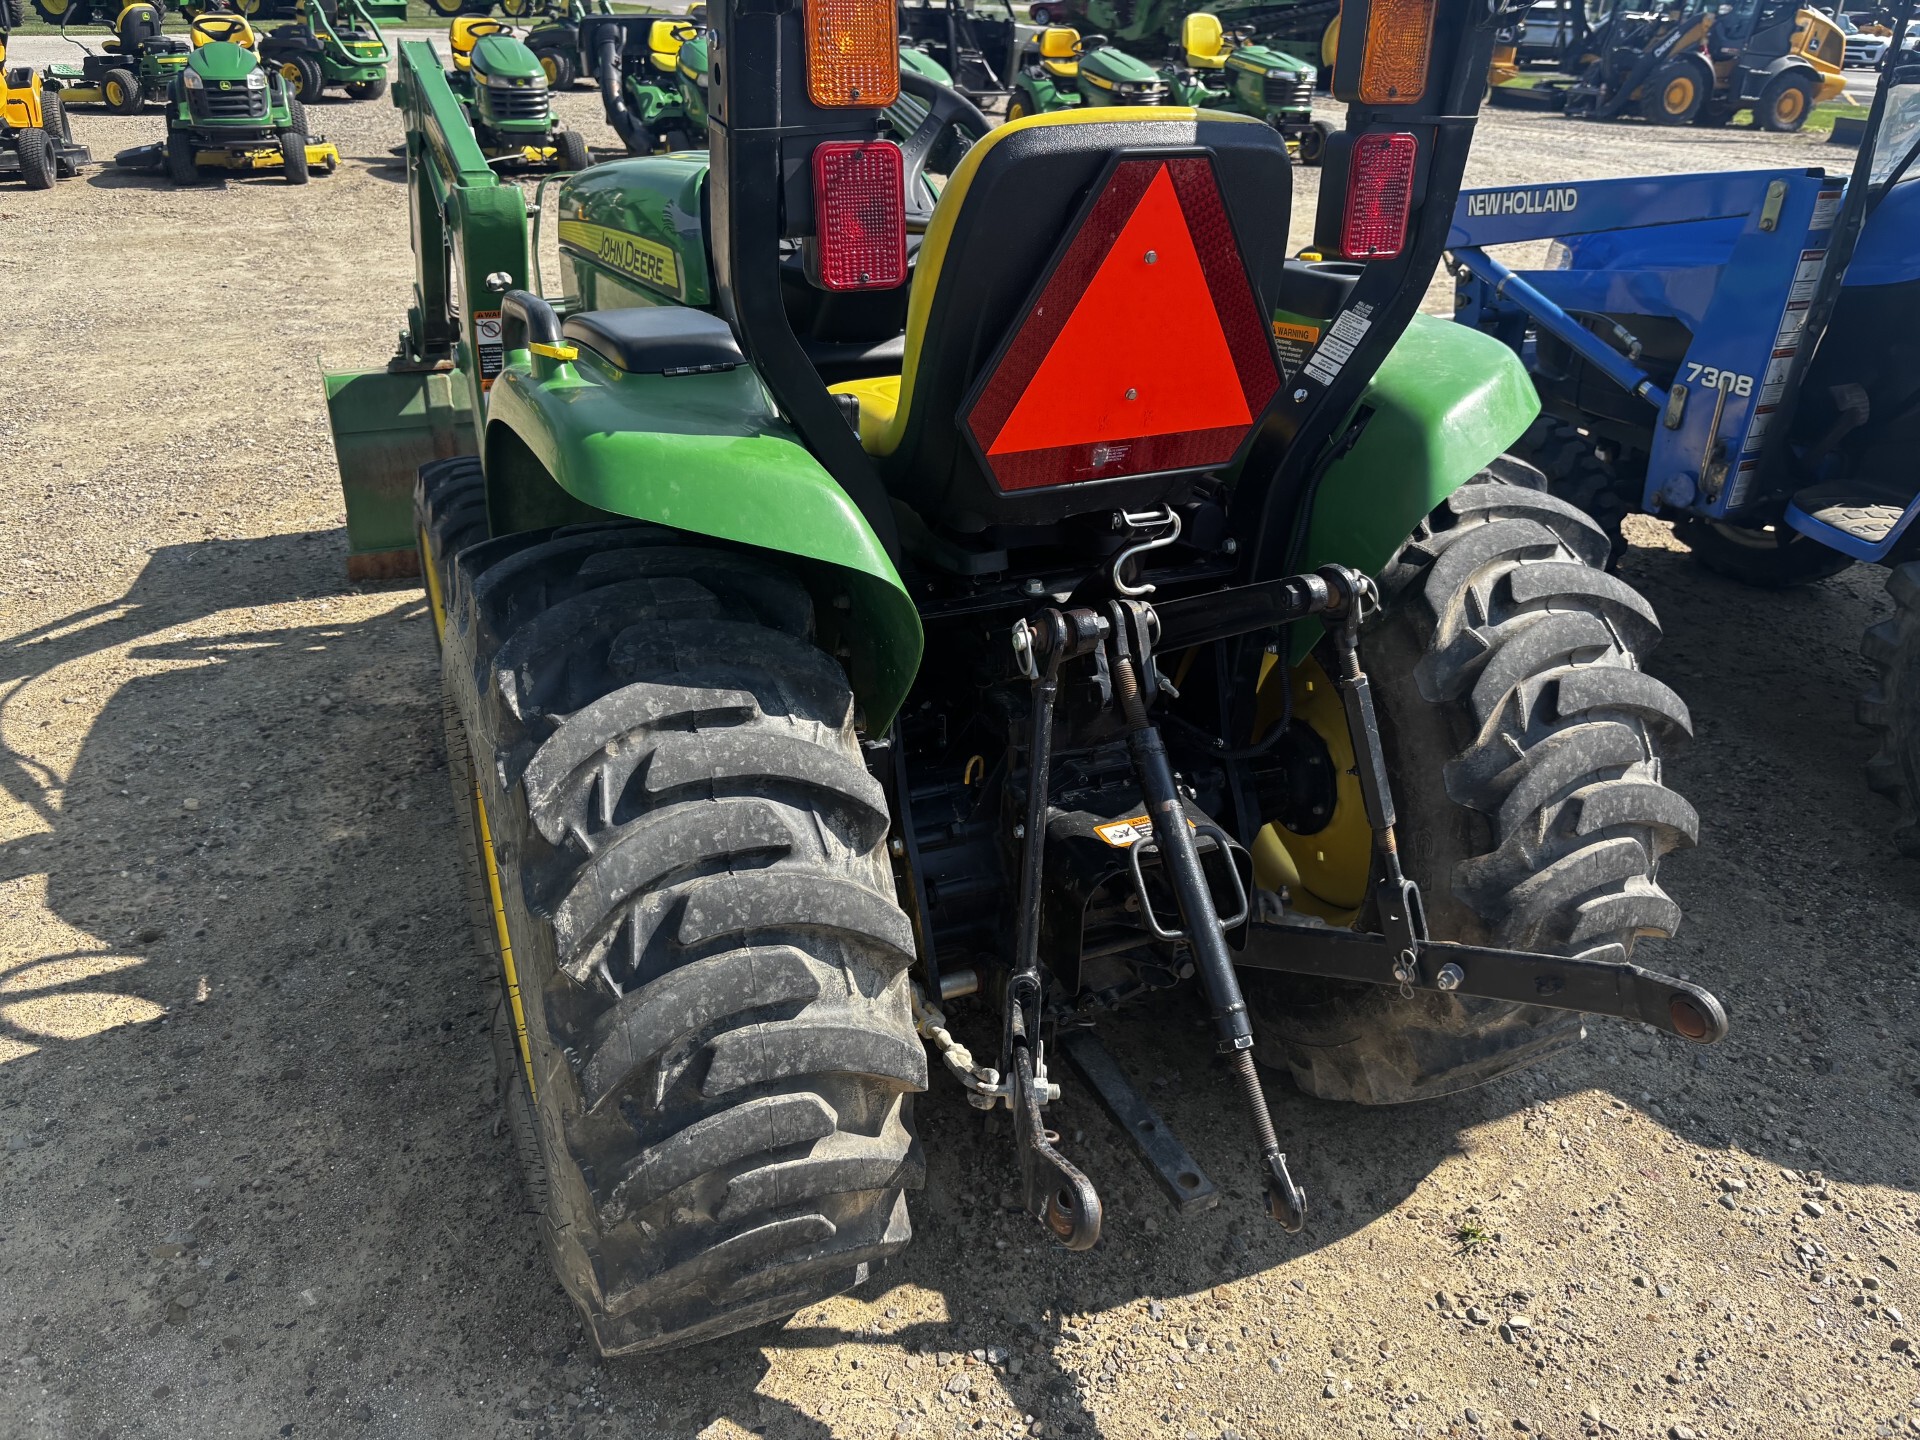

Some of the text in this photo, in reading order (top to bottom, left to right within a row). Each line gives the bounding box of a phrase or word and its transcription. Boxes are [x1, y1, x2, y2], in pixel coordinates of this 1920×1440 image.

[1467, 188, 1578, 217] NEW HOLLAND
[598, 231, 665, 282] JOHN DEERE
[1277, 326, 1309, 340] WARNING
[1686, 361, 1754, 397] 7308
